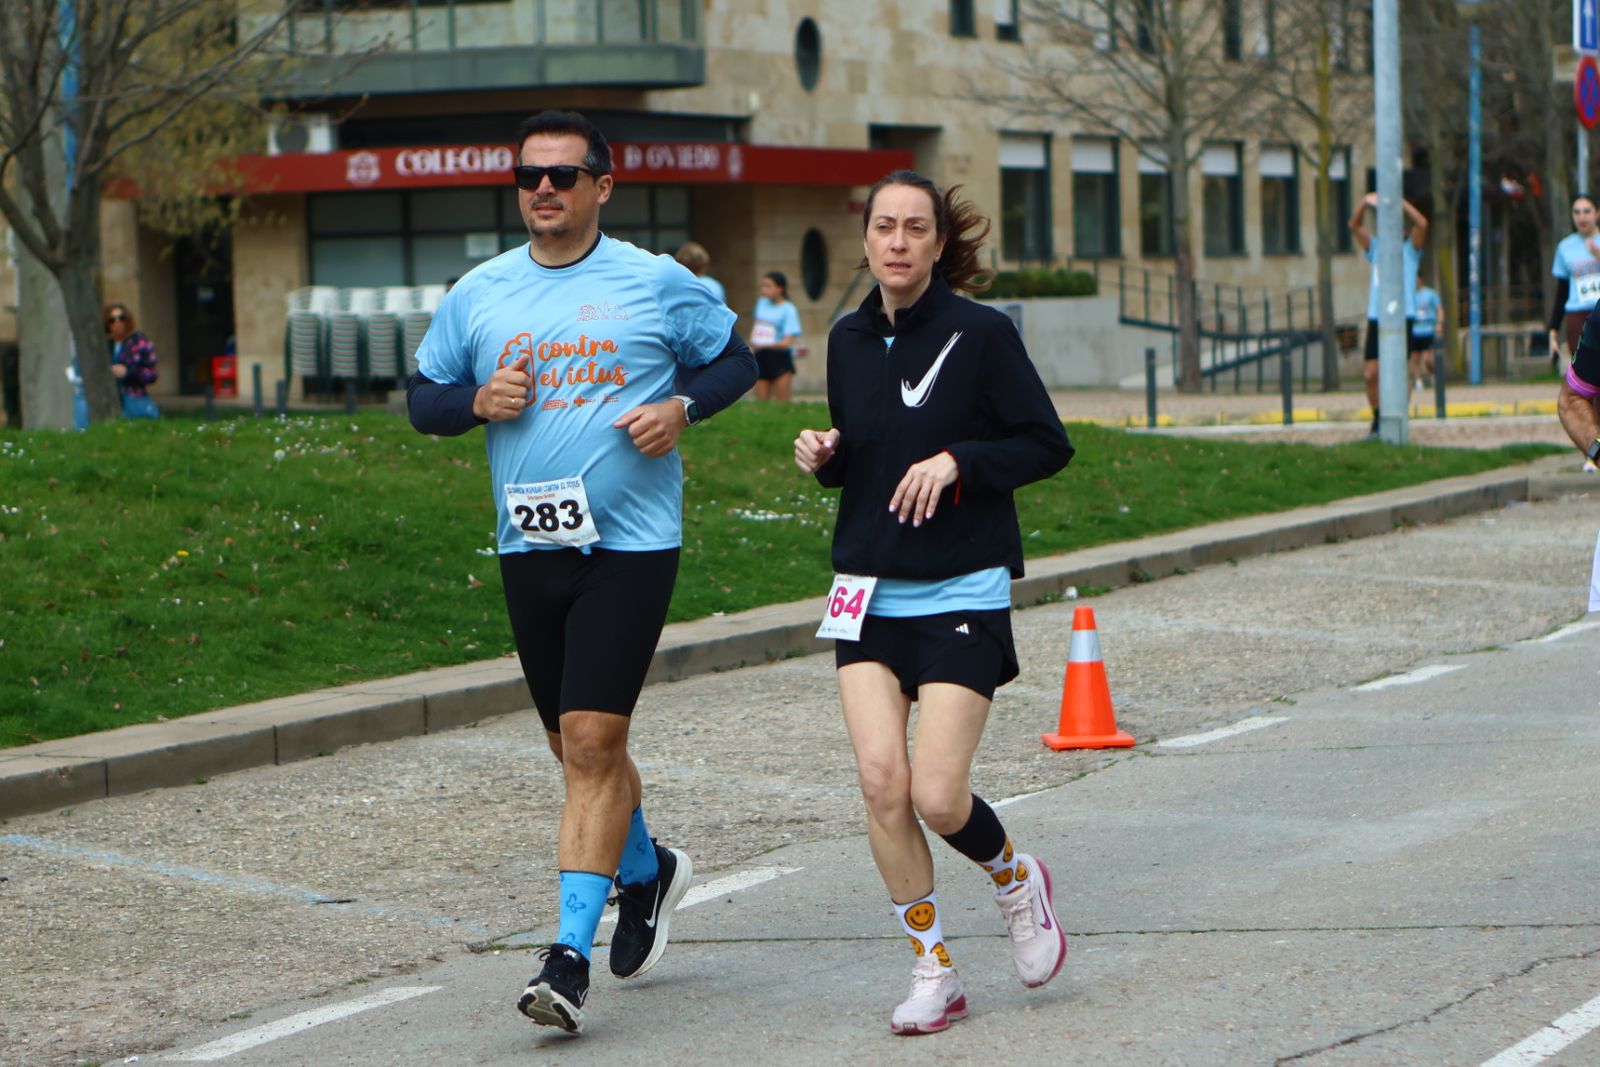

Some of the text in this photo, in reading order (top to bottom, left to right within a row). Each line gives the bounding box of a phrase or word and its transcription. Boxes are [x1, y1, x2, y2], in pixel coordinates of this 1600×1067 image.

[395, 146, 513, 176] COLEGIO
[538, 335, 619, 361] contra
[540, 360, 629, 388] el ictus
[514, 499, 583, 532] 283
[827, 586, 865, 620] 64
